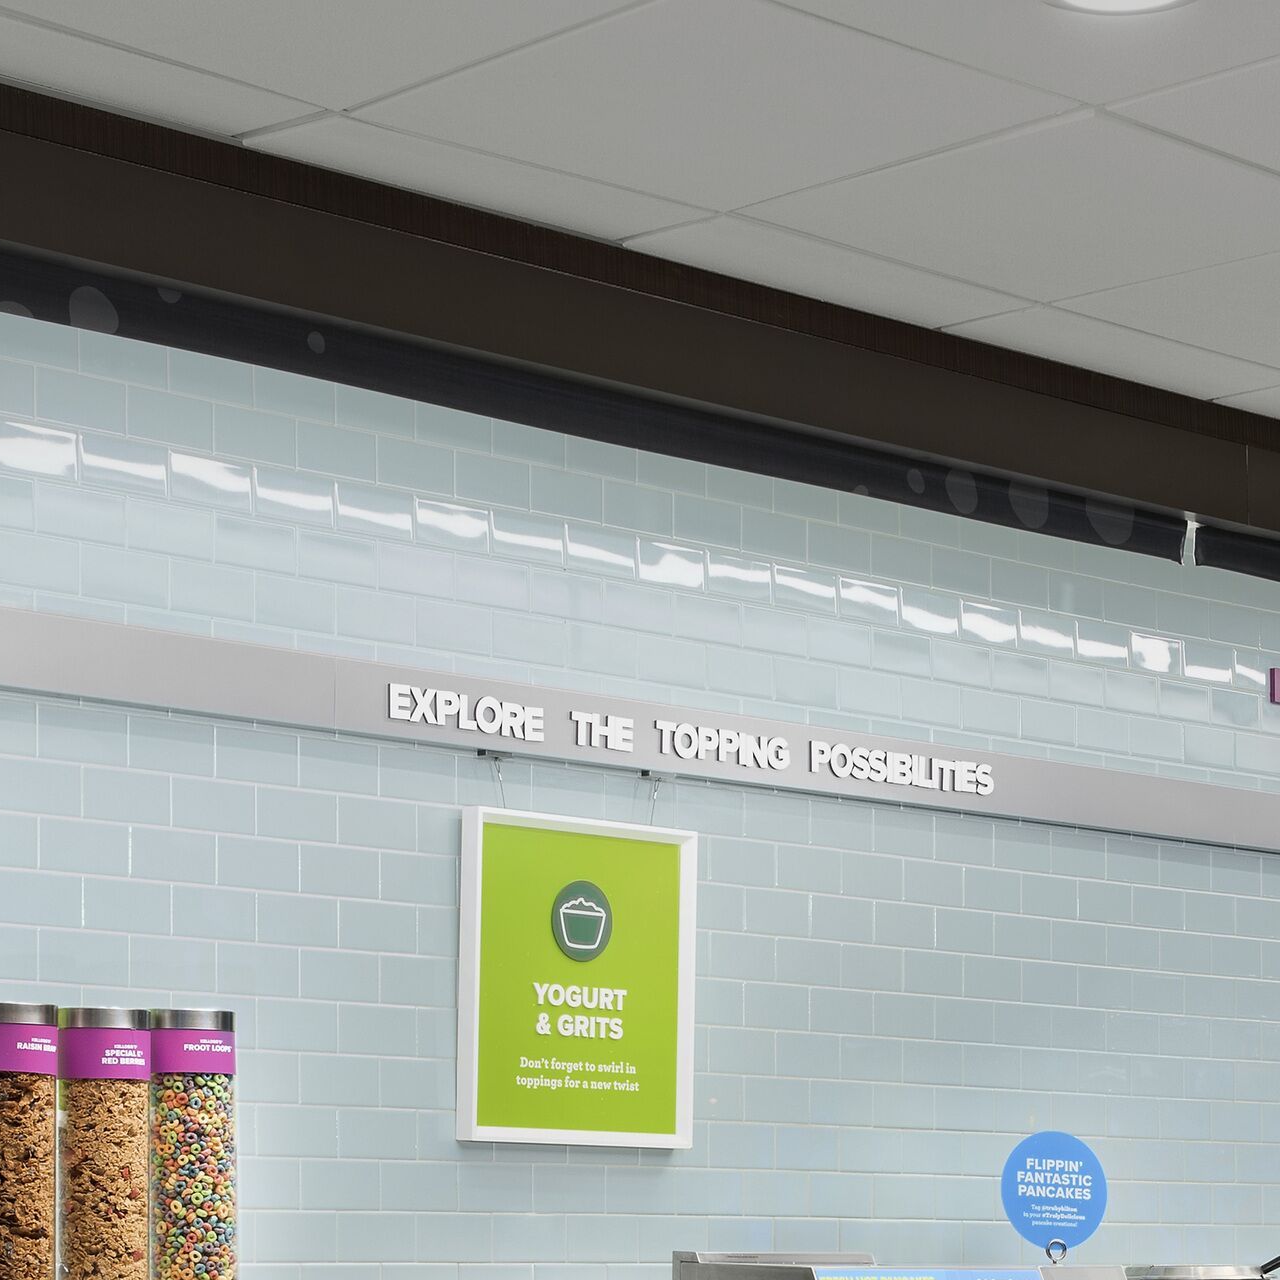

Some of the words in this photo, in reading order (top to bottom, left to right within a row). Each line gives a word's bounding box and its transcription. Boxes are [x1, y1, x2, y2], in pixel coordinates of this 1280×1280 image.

[387, 682, 544, 743] EXPLORE
[570, 710, 635, 753] THE
[655, 718, 791, 771] TOPPING
[810, 739, 995, 797] POSSIBILITIES
[533, 982, 627, 1011] YOGURT
[535, 1012, 552, 1036] &
[557, 1014, 624, 1040] GRITS
[16, 1042, 42, 1051] RAISIN
[104, 1049, 136, 1057] SPECIAL
[184, 1044, 210, 1052] FROOT
[520, 1056, 549, 1069] Don't
[551, 1058, 583, 1073] forget
[585, 1061, 596, 1072] to
[598, 1061, 624, 1074] swirl
[626, 1062, 636, 1074] in
[516, 1075, 562, 1089] toppings
[564, 1076, 580, 1088] for
[582, 1080, 588, 1088] a
[590, 1080, 612, 1090] new
[613, 1080, 640, 1092] twist
[1026, 1158, 1083, 1172] FLIPPIN'
[1016, 1171, 1092, 1187] FANTASTIC
[1018, 1184, 1092, 1200] PANCAKES
